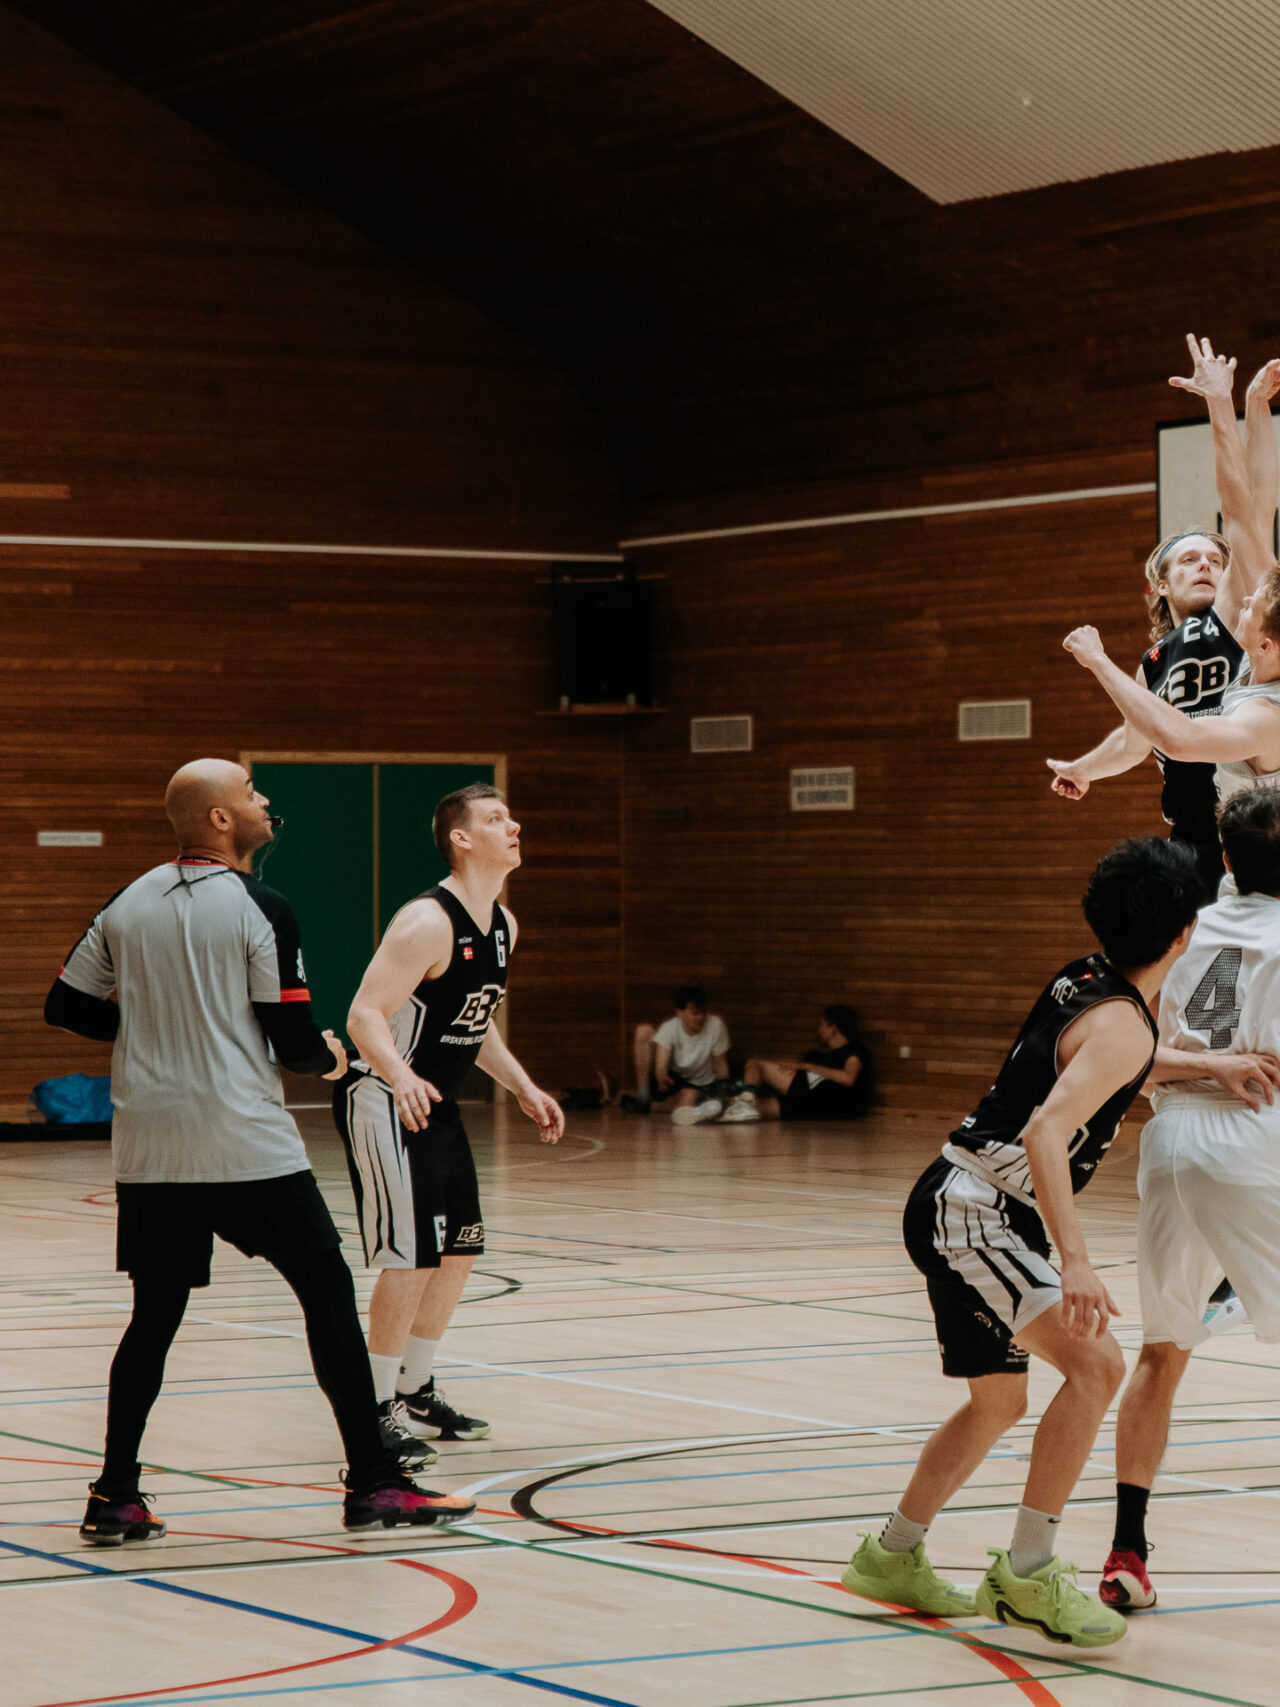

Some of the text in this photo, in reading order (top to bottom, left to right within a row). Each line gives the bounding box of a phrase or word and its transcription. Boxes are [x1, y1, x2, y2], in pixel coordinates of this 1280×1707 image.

[1183, 615, 1220, 643] 24
[1157, 656, 1230, 709] 3B
[495, 929, 507, 968] 6
[450, 984, 506, 1032] B3
[1184, 947, 1243, 1049] 4
[433, 1215, 447, 1252] 6
